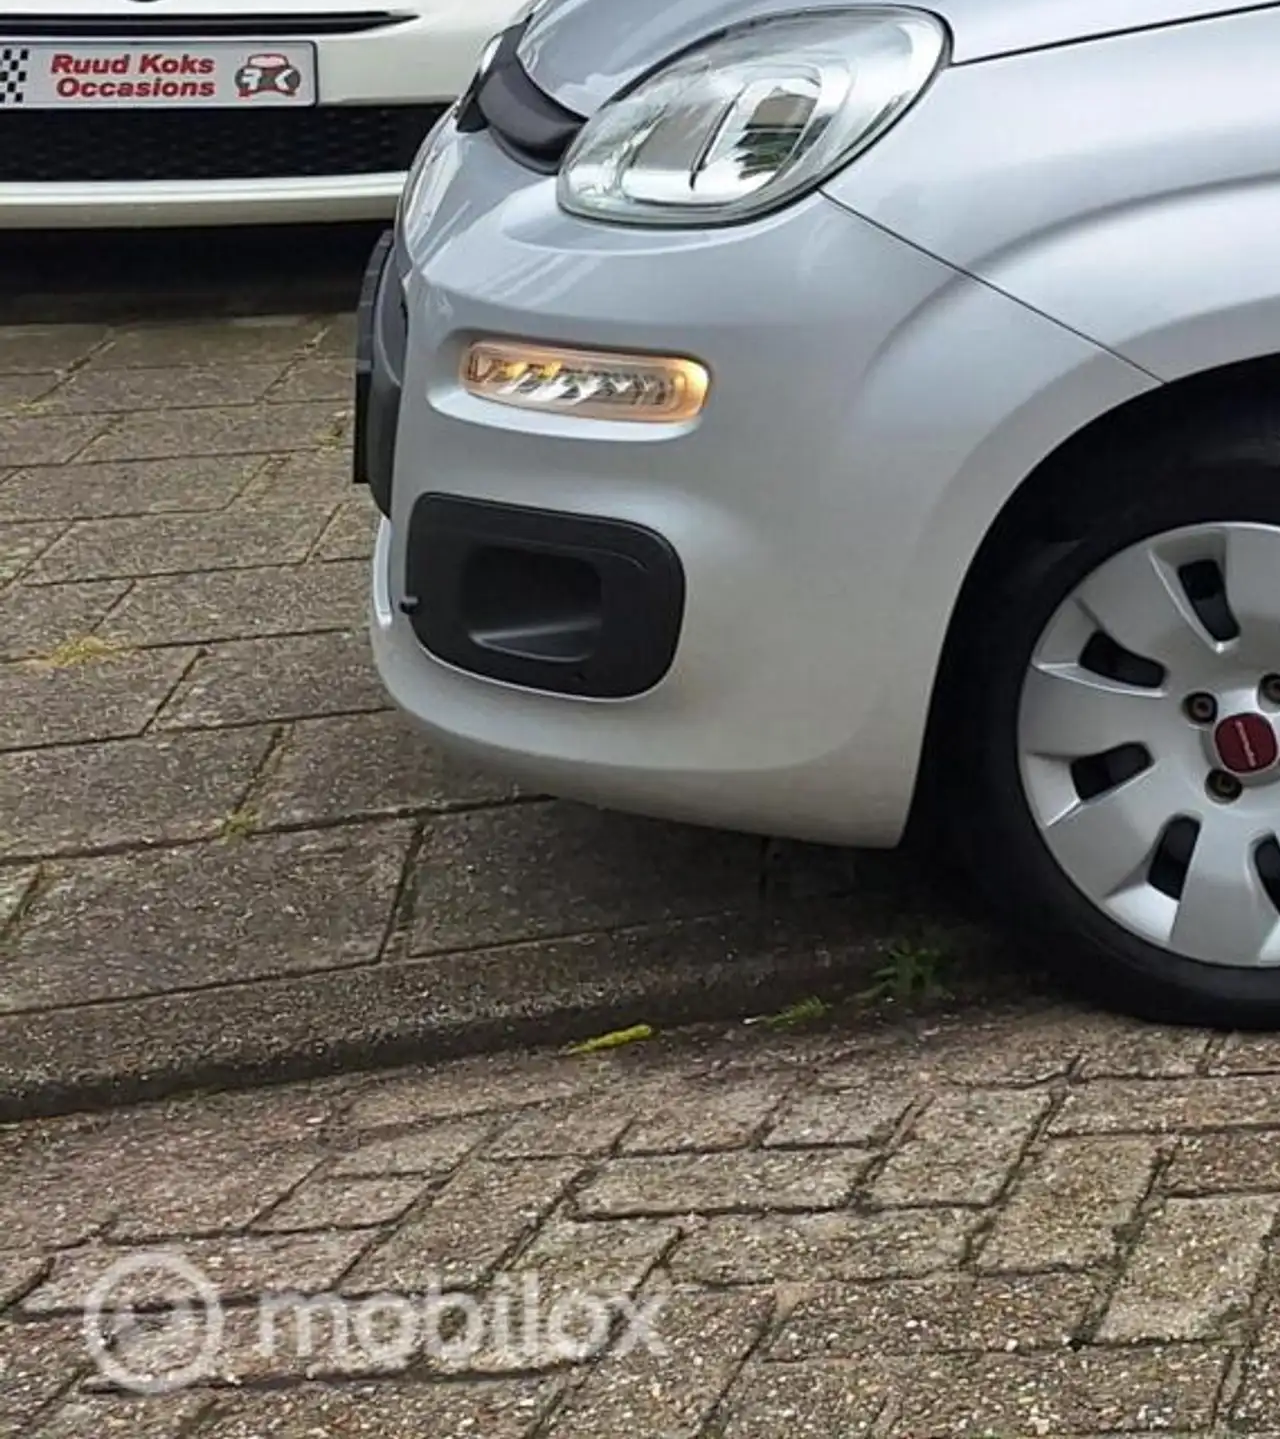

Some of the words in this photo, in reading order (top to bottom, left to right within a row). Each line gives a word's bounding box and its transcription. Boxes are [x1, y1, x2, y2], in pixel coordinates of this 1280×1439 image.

[50, 53, 131, 75] Ruud
[138, 53, 216, 75] Koks
[56, 77, 216, 98] Occasions
